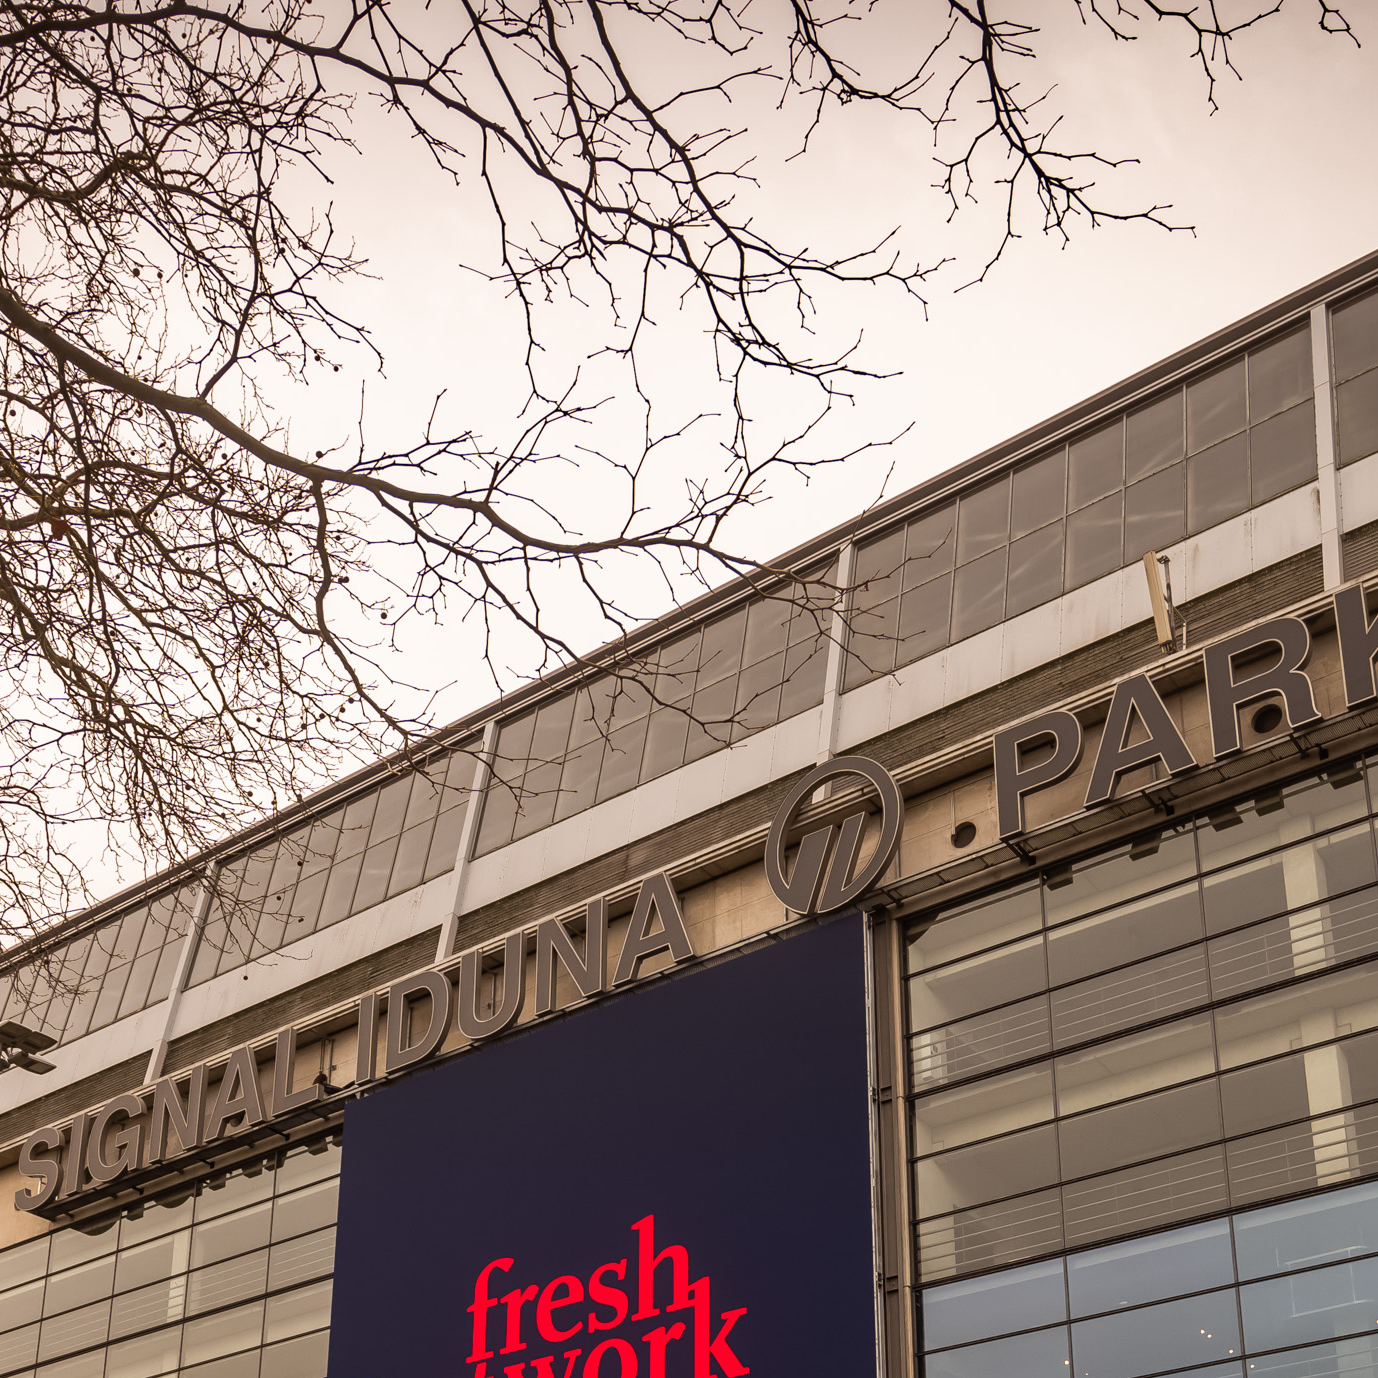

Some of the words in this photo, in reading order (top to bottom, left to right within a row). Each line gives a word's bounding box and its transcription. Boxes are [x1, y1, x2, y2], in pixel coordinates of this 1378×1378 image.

[14, 1026, 328, 1213] SIGNAL
[355, 870, 697, 1087] IDUNA
[465, 1214, 696, 1364] fresh
